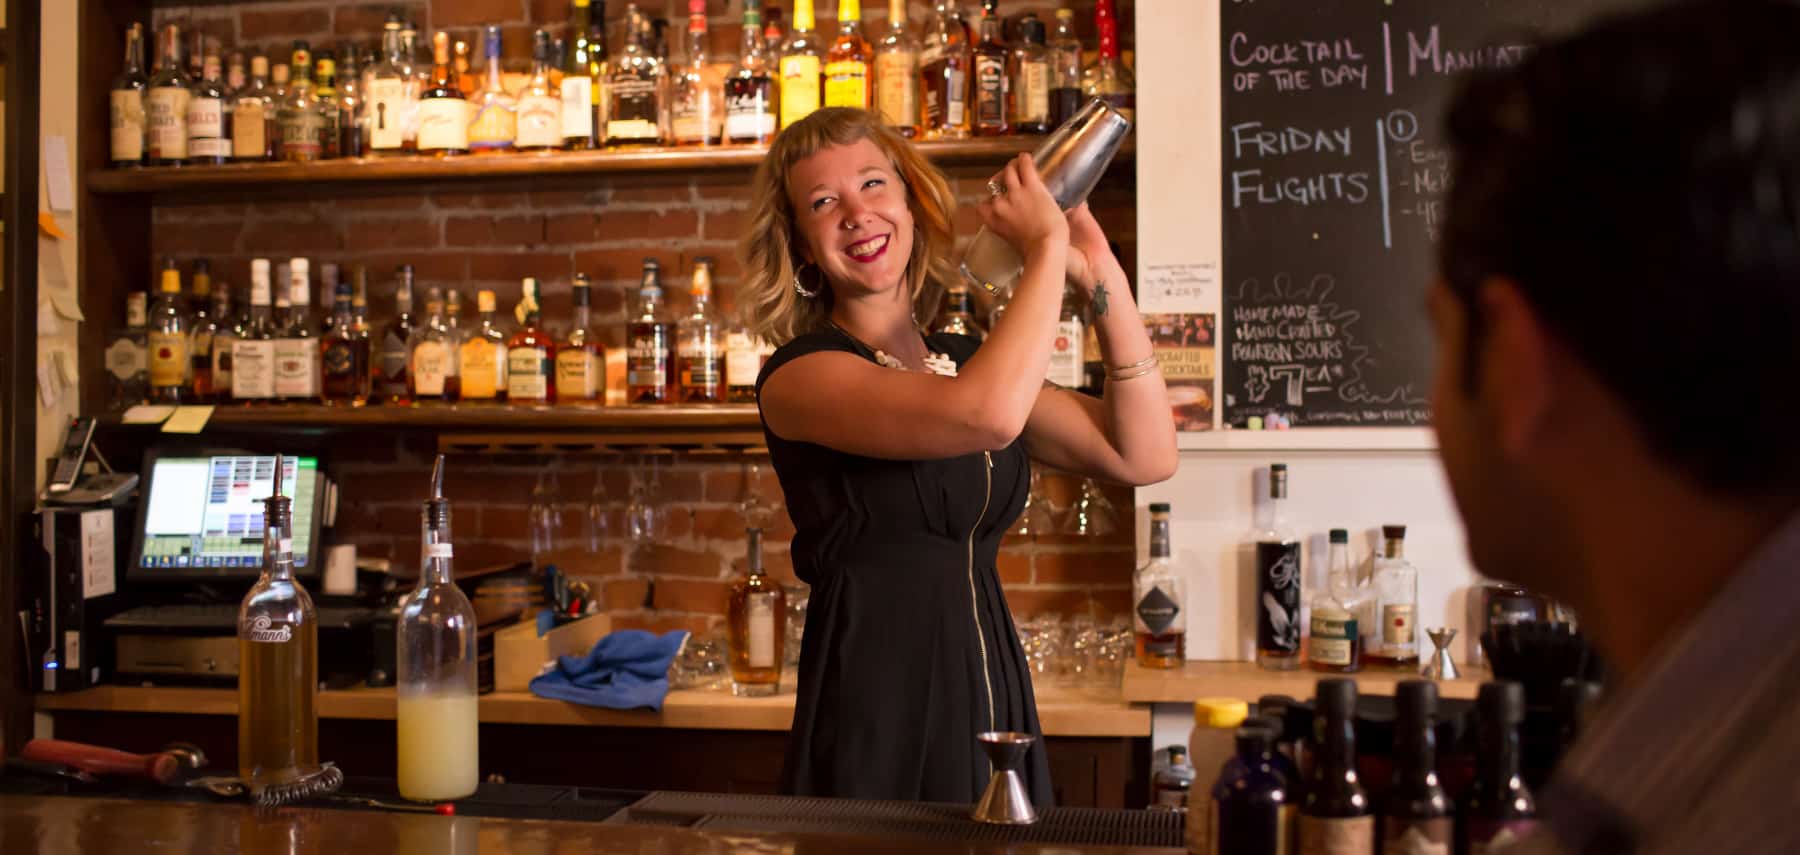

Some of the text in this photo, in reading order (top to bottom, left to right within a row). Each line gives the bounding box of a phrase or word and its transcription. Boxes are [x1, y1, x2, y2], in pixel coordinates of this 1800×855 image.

[1230, 31, 1363, 66] COCKTAIL
[1407, 25, 1529, 77] MANHAT
[1233, 64, 1368, 92] OF THE DAY
[1232, 122, 1351, 158] FRIDAY
[1409, 140, 1449, 171] Eag
[1232, 169, 1369, 208] FLIGHTS
